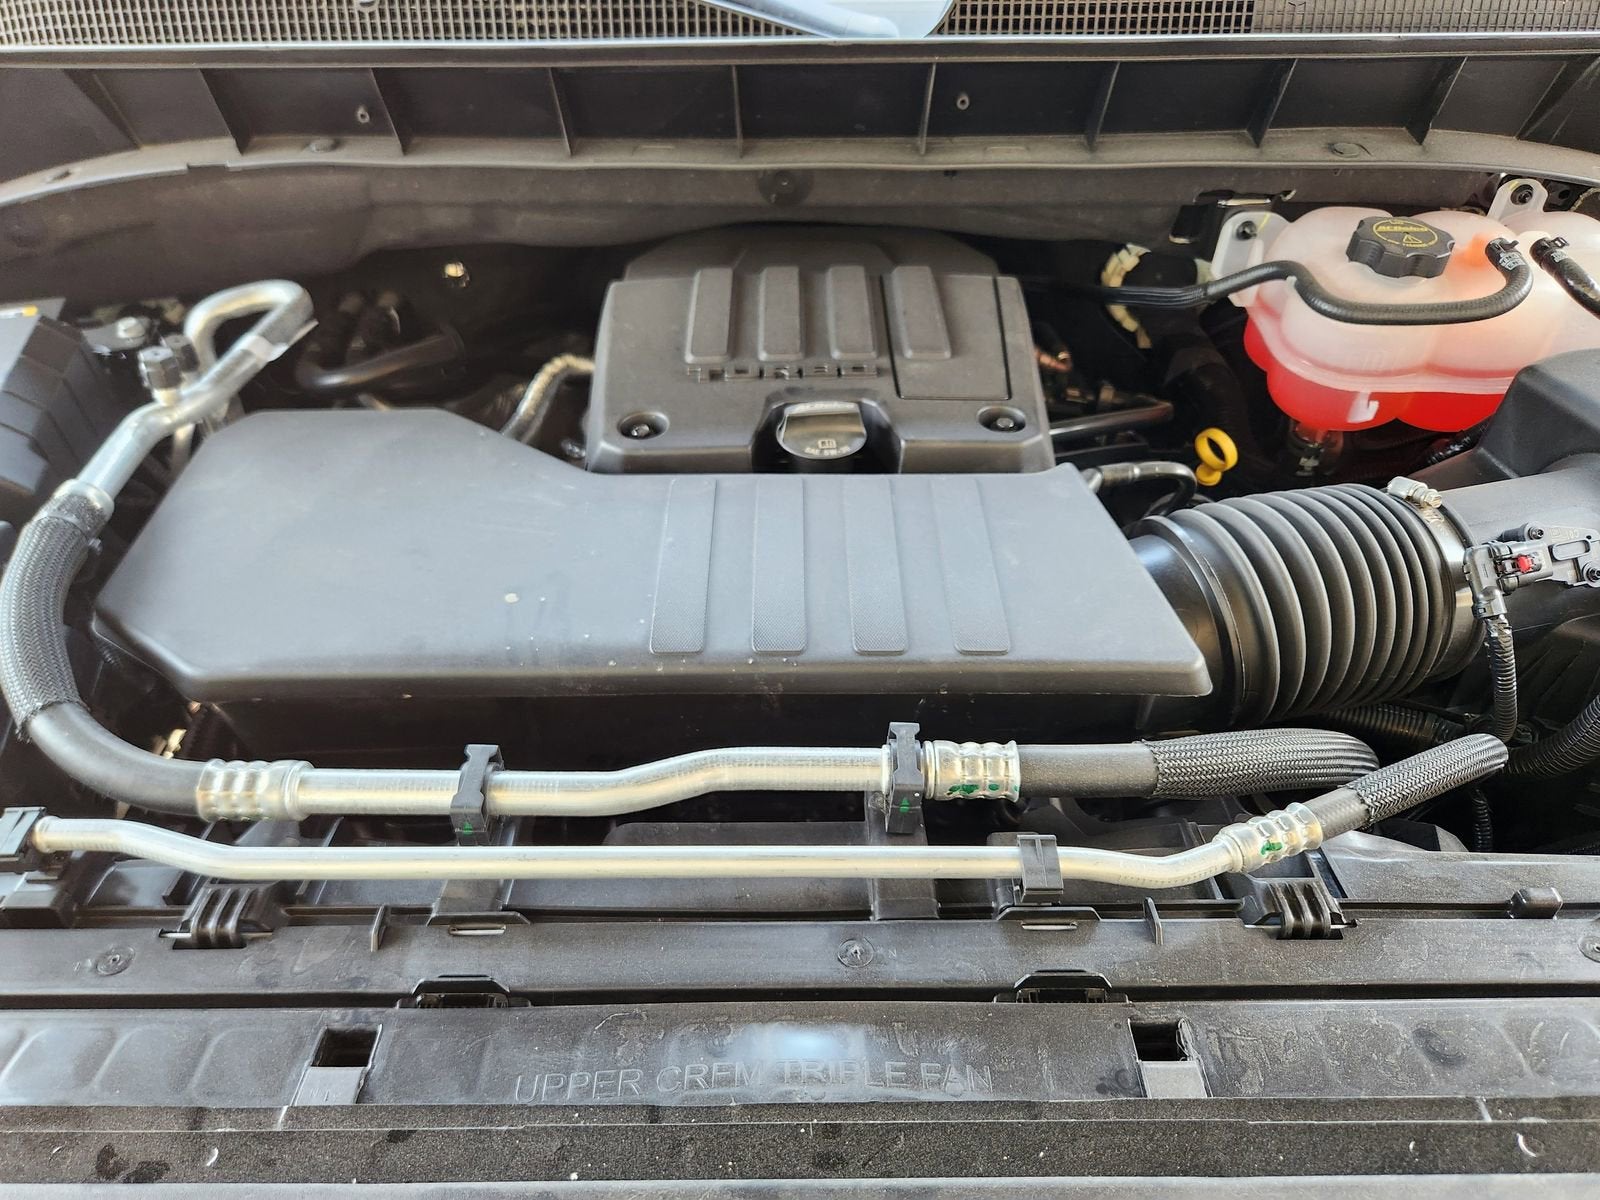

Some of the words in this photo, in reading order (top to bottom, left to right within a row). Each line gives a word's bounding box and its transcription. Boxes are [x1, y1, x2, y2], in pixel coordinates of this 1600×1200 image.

[515, 1068, 644, 1103] UPPER
[777, 1058, 911, 1089] TRIPLE
[919, 1061, 994, 1094] FAN
